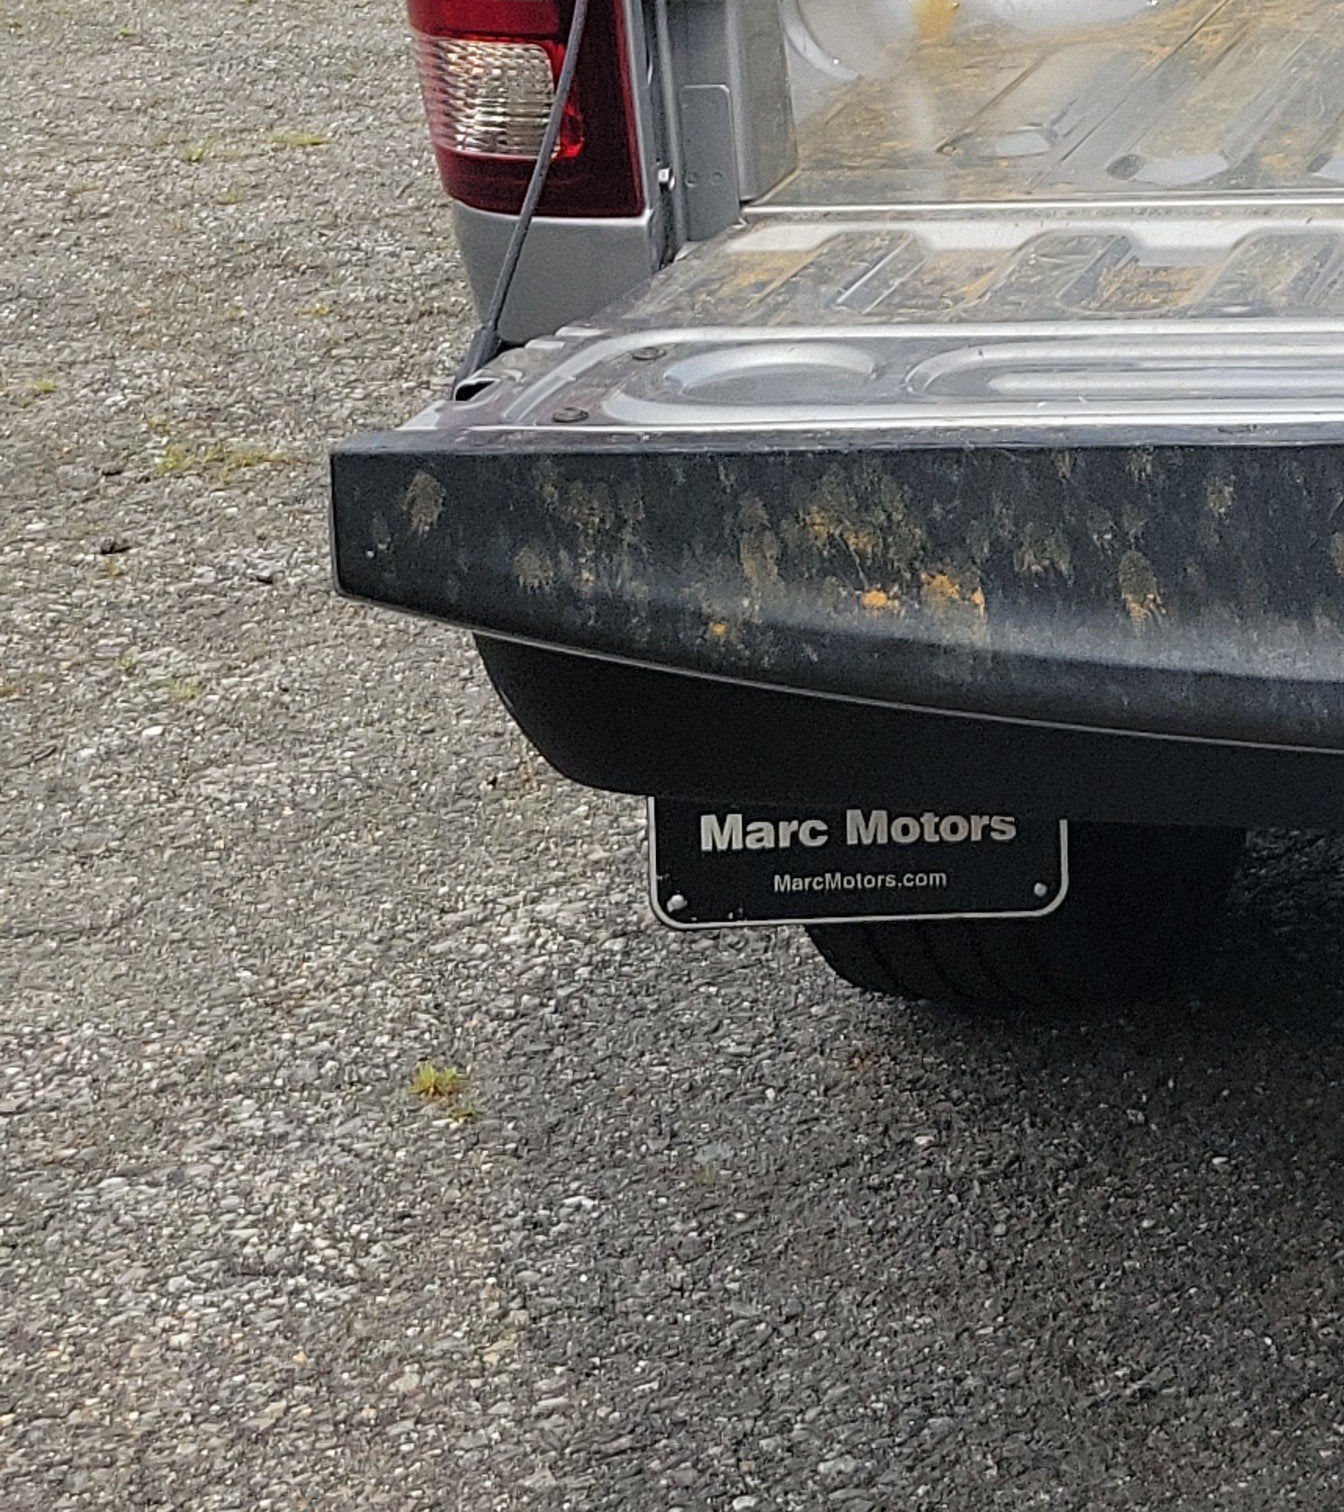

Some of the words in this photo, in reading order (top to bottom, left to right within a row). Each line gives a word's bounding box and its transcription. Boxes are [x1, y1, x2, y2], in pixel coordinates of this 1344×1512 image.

[700, 813, 829, 851] Marc
[846, 809, 1017, 845] Motors
[773, 872, 948, 892] MarcMotors.com
